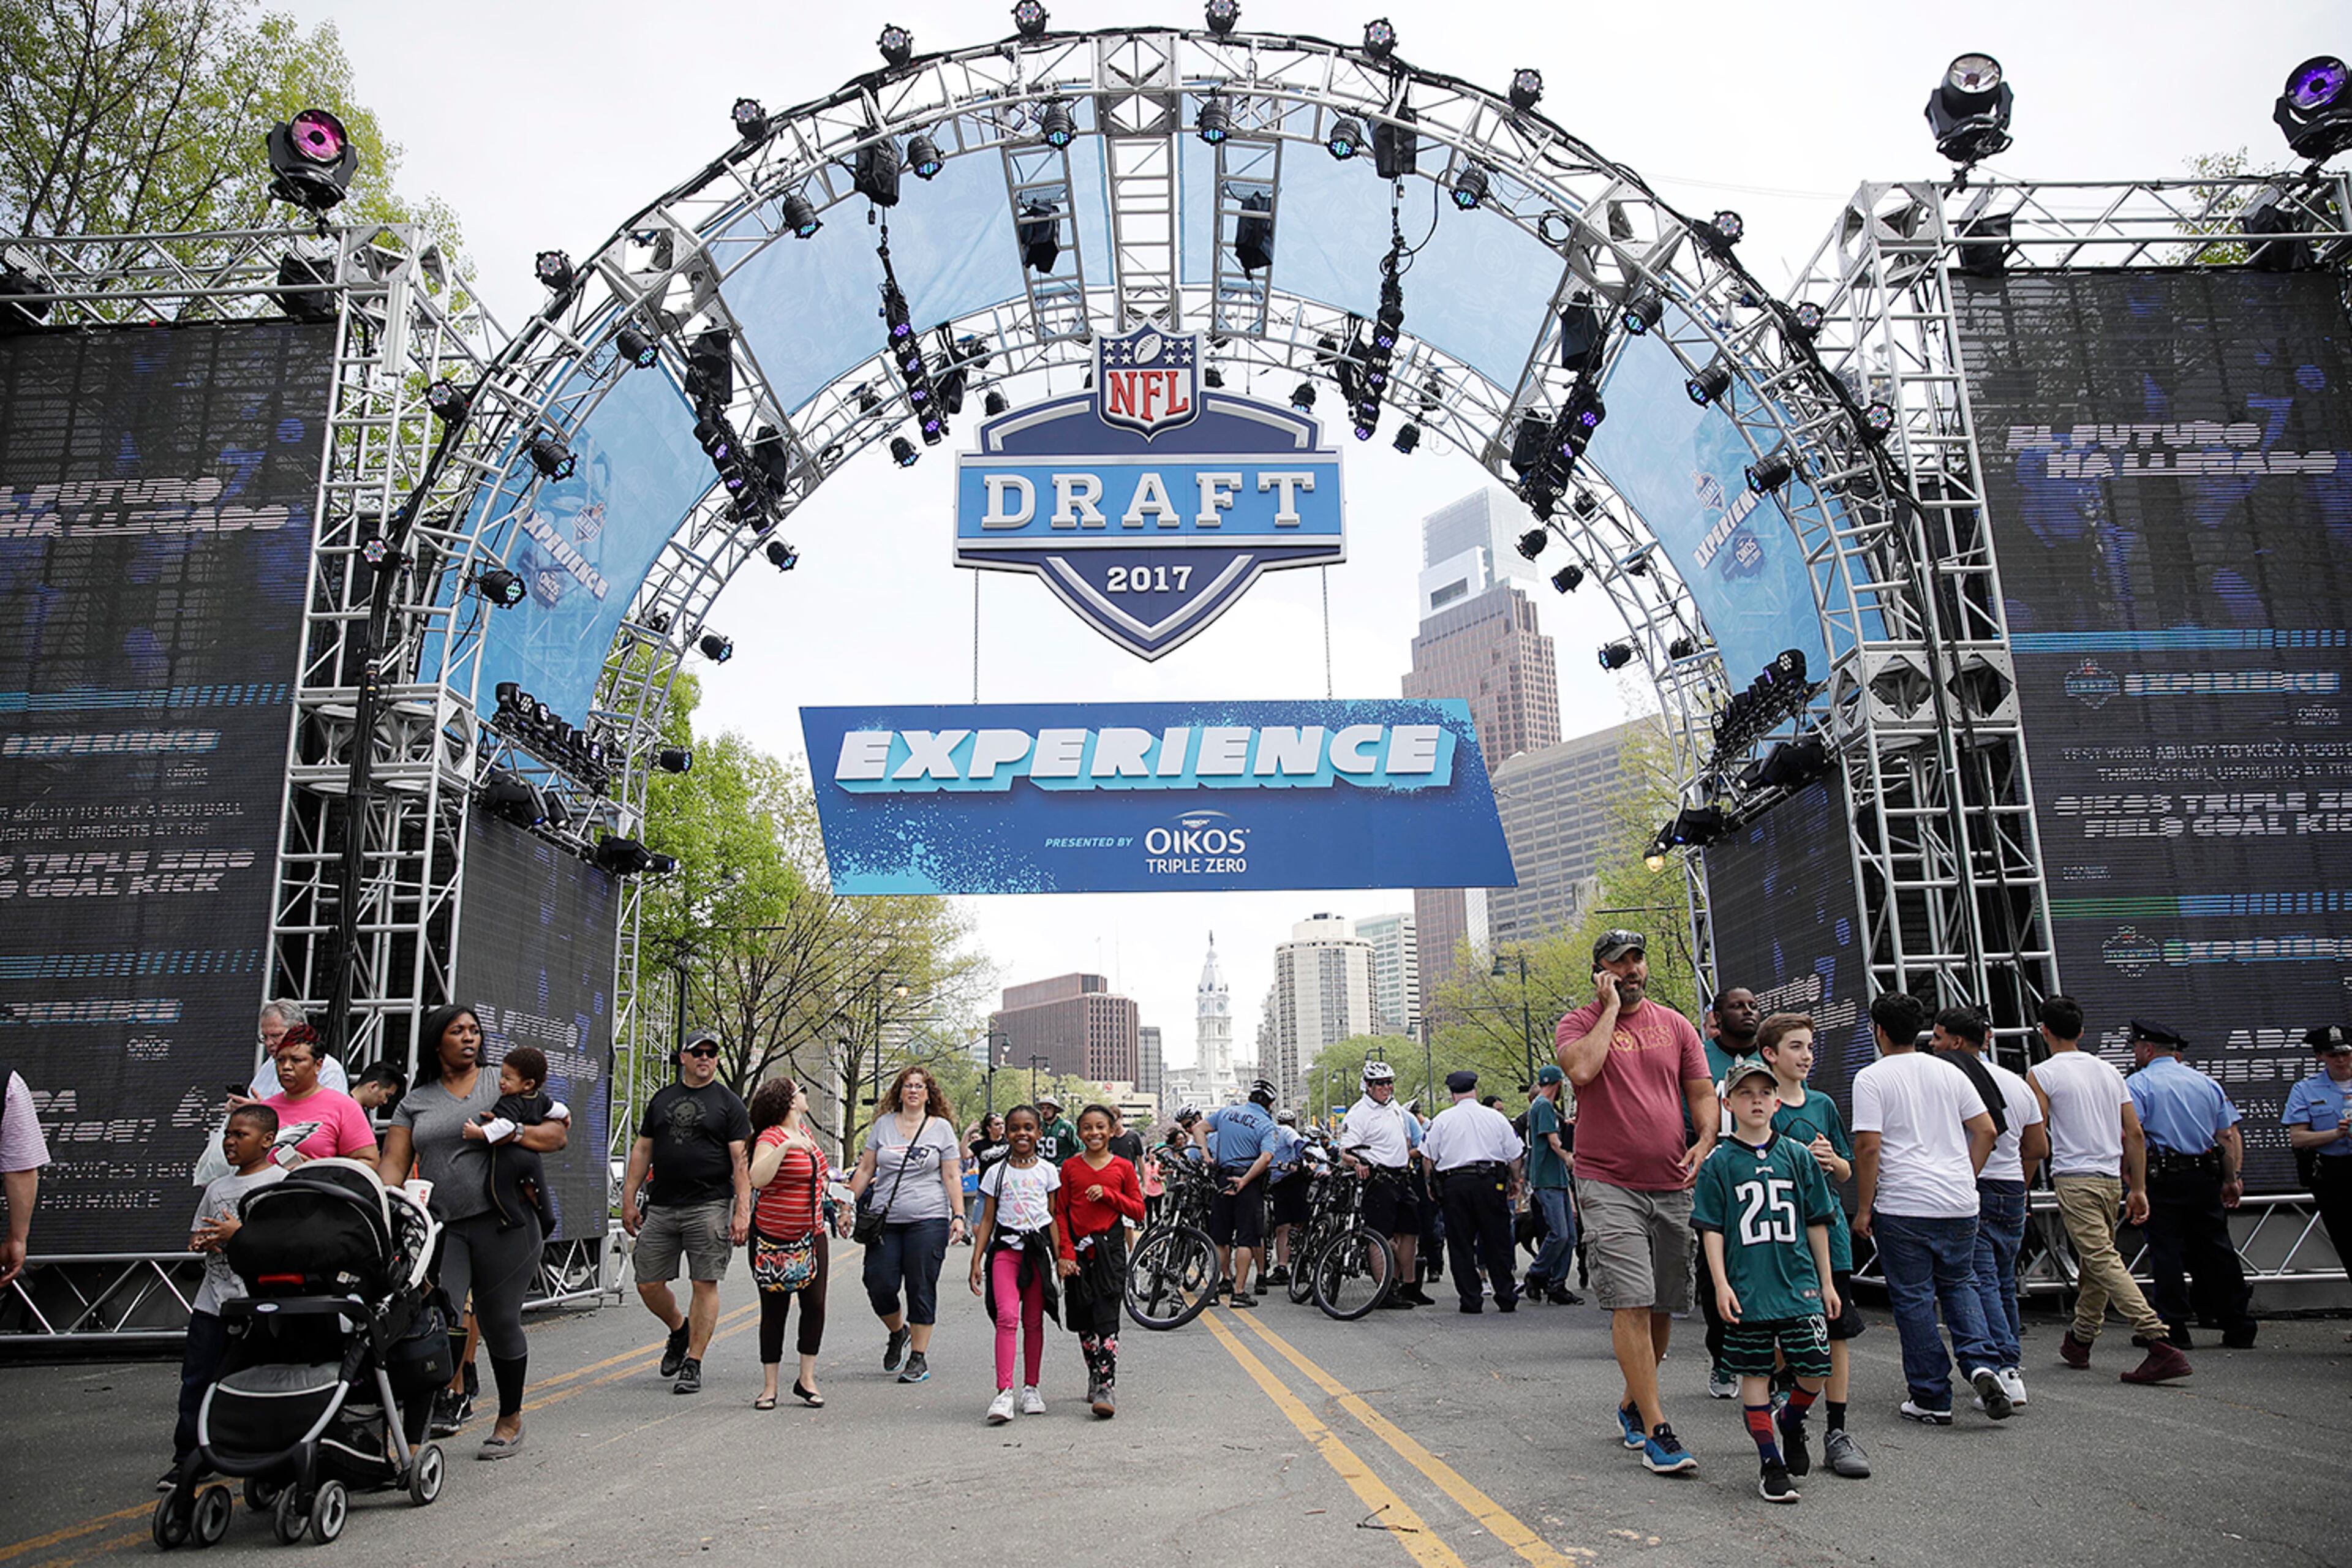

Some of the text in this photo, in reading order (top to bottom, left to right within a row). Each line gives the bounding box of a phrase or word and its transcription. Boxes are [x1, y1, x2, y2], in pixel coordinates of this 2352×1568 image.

[1109, 371, 1189, 423] NFL
[981, 472, 1315, 529] DRAFT
[1693, 488, 1762, 568] EXPERIEN
[1107, 565, 1193, 592] 2017
[834, 724, 1442, 781] EXPERIENCE
[2155, 745, 2216, 760] ABILITY
[2220, 744, 2241, 758] TO
[2244, 743, 2285, 757] KICK
[2180, 793, 2307, 814] TRIPLE
[69, 824, 151, 840] UPRIGHTS
[2084, 816, 2184, 838] FIELD
[2192, 815, 2287, 836] GOAL
[1045, 837, 1134, 848] PRESENTED BY
[1145, 827, 1246, 856] OIKOS
[23, 850, 151, 875] TRIPLE
[1146, 858, 1247, 874] TRIPLE ZERO
[26, 877, 121, 899] GOAL
[128, 873, 225, 895] KICK
[40, 1118, 156, 1142] TION?
[1223, 1110, 1260, 1129] POLICE
[1036, 1136, 1057, 1158] 59
[38, 1161, 197, 1180] ERVICES TEN
[40, 1191, 162, 1210] ENTRANCE
[1735, 1179, 1796, 1246] 25
